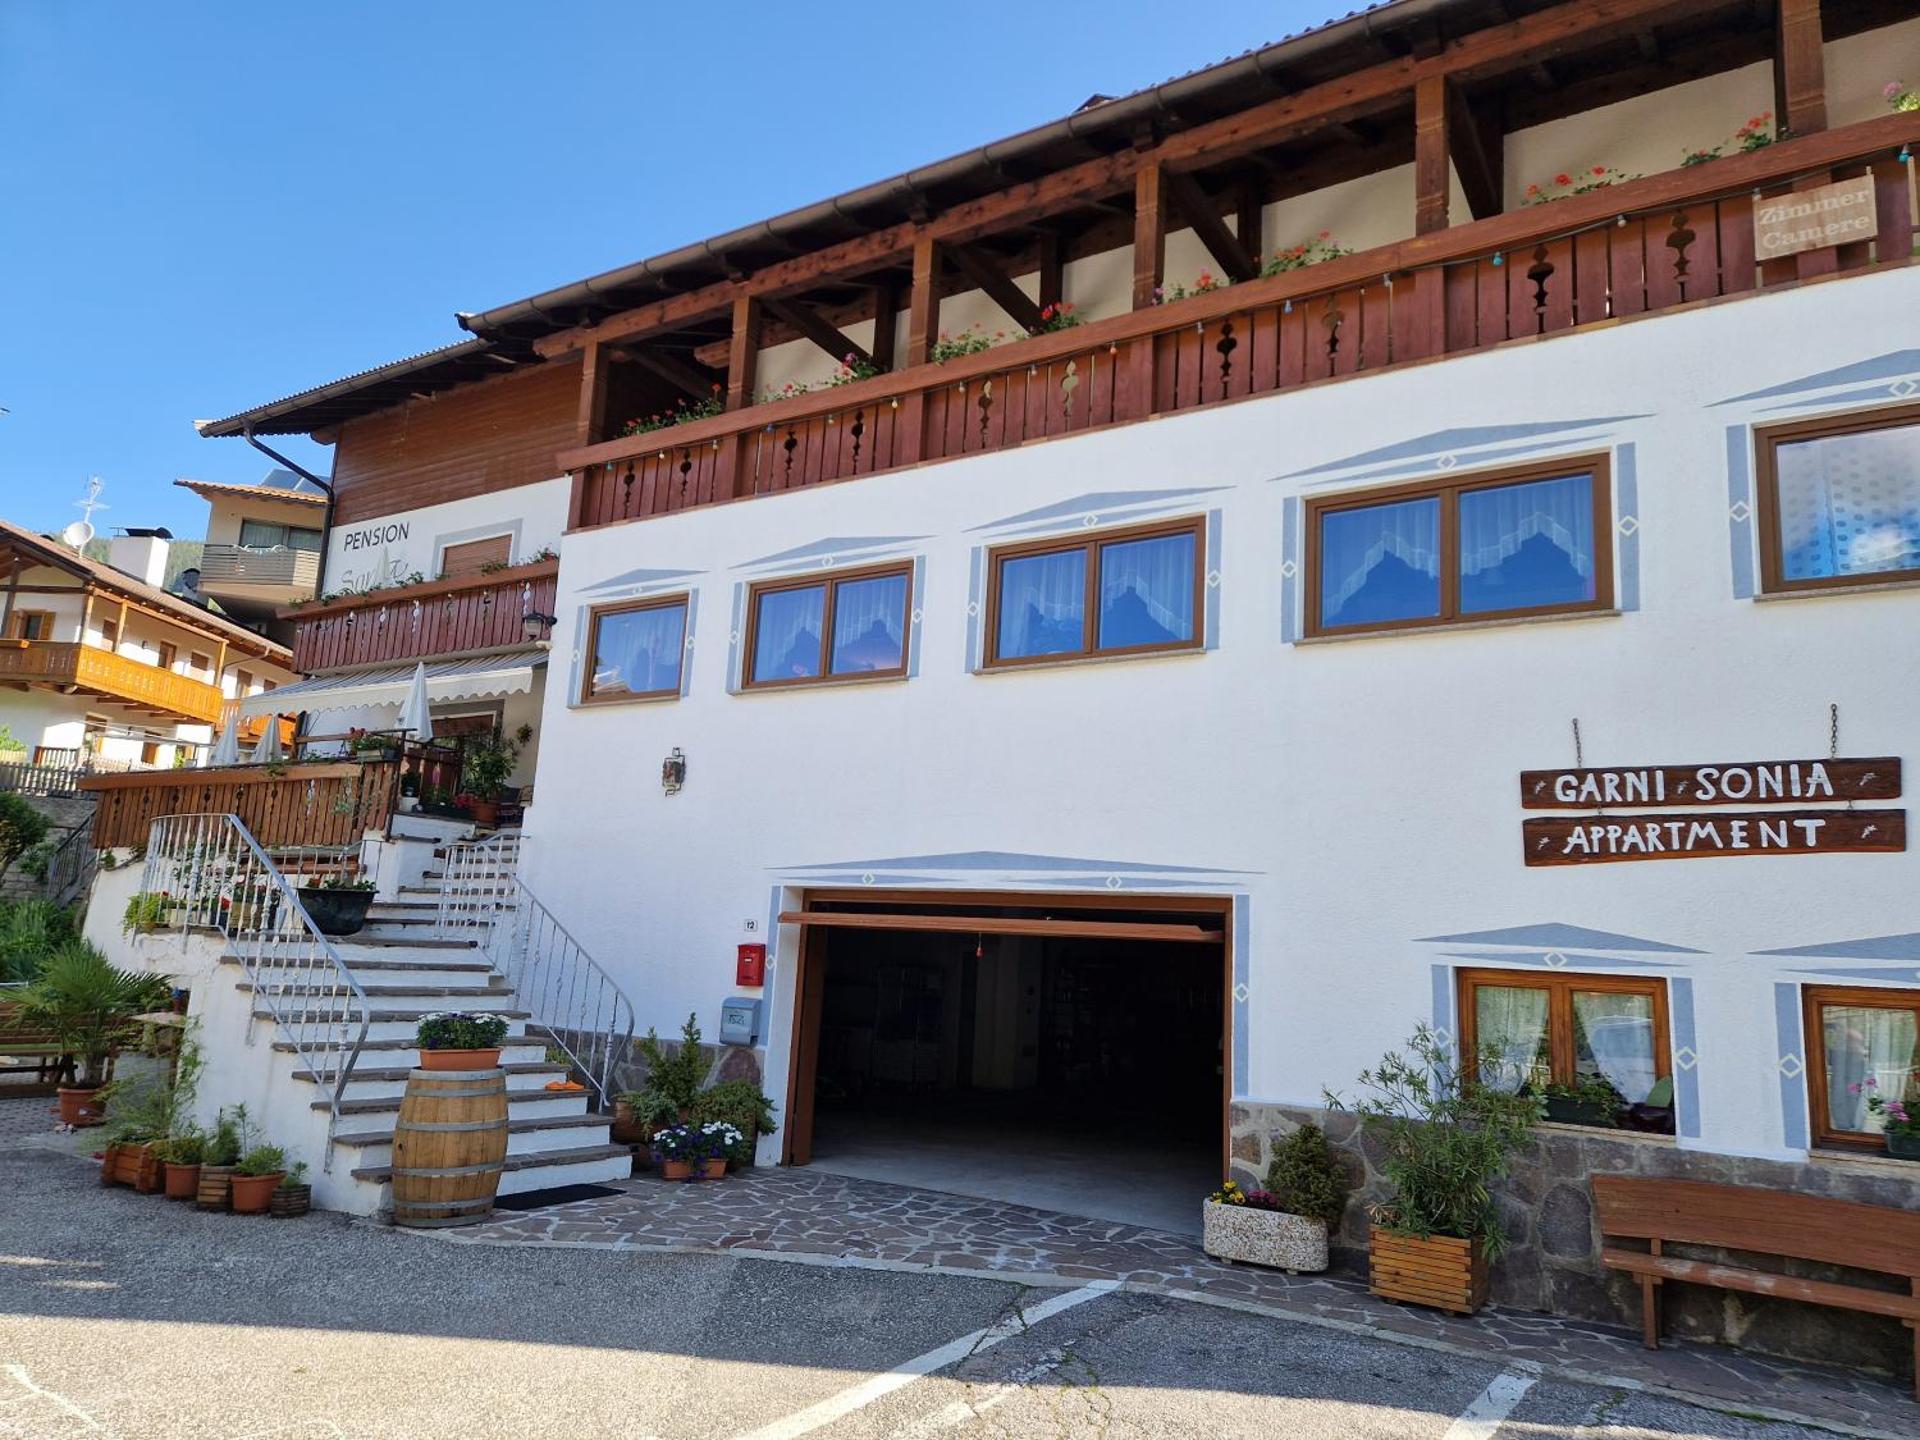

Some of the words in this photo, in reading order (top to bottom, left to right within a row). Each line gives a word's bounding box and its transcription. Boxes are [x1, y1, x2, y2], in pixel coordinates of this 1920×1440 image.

[1759, 188, 1869, 225] Zimmer
[1763, 215, 1871, 249] Camere
[344, 521, 410, 552] PENSION
[1554, 770, 1665, 803] GARNI
[1695, 762, 1834, 801] SONIA
[1562, 818, 1826, 854] APPARTMENT
[746, 921, 755, 929] 12
